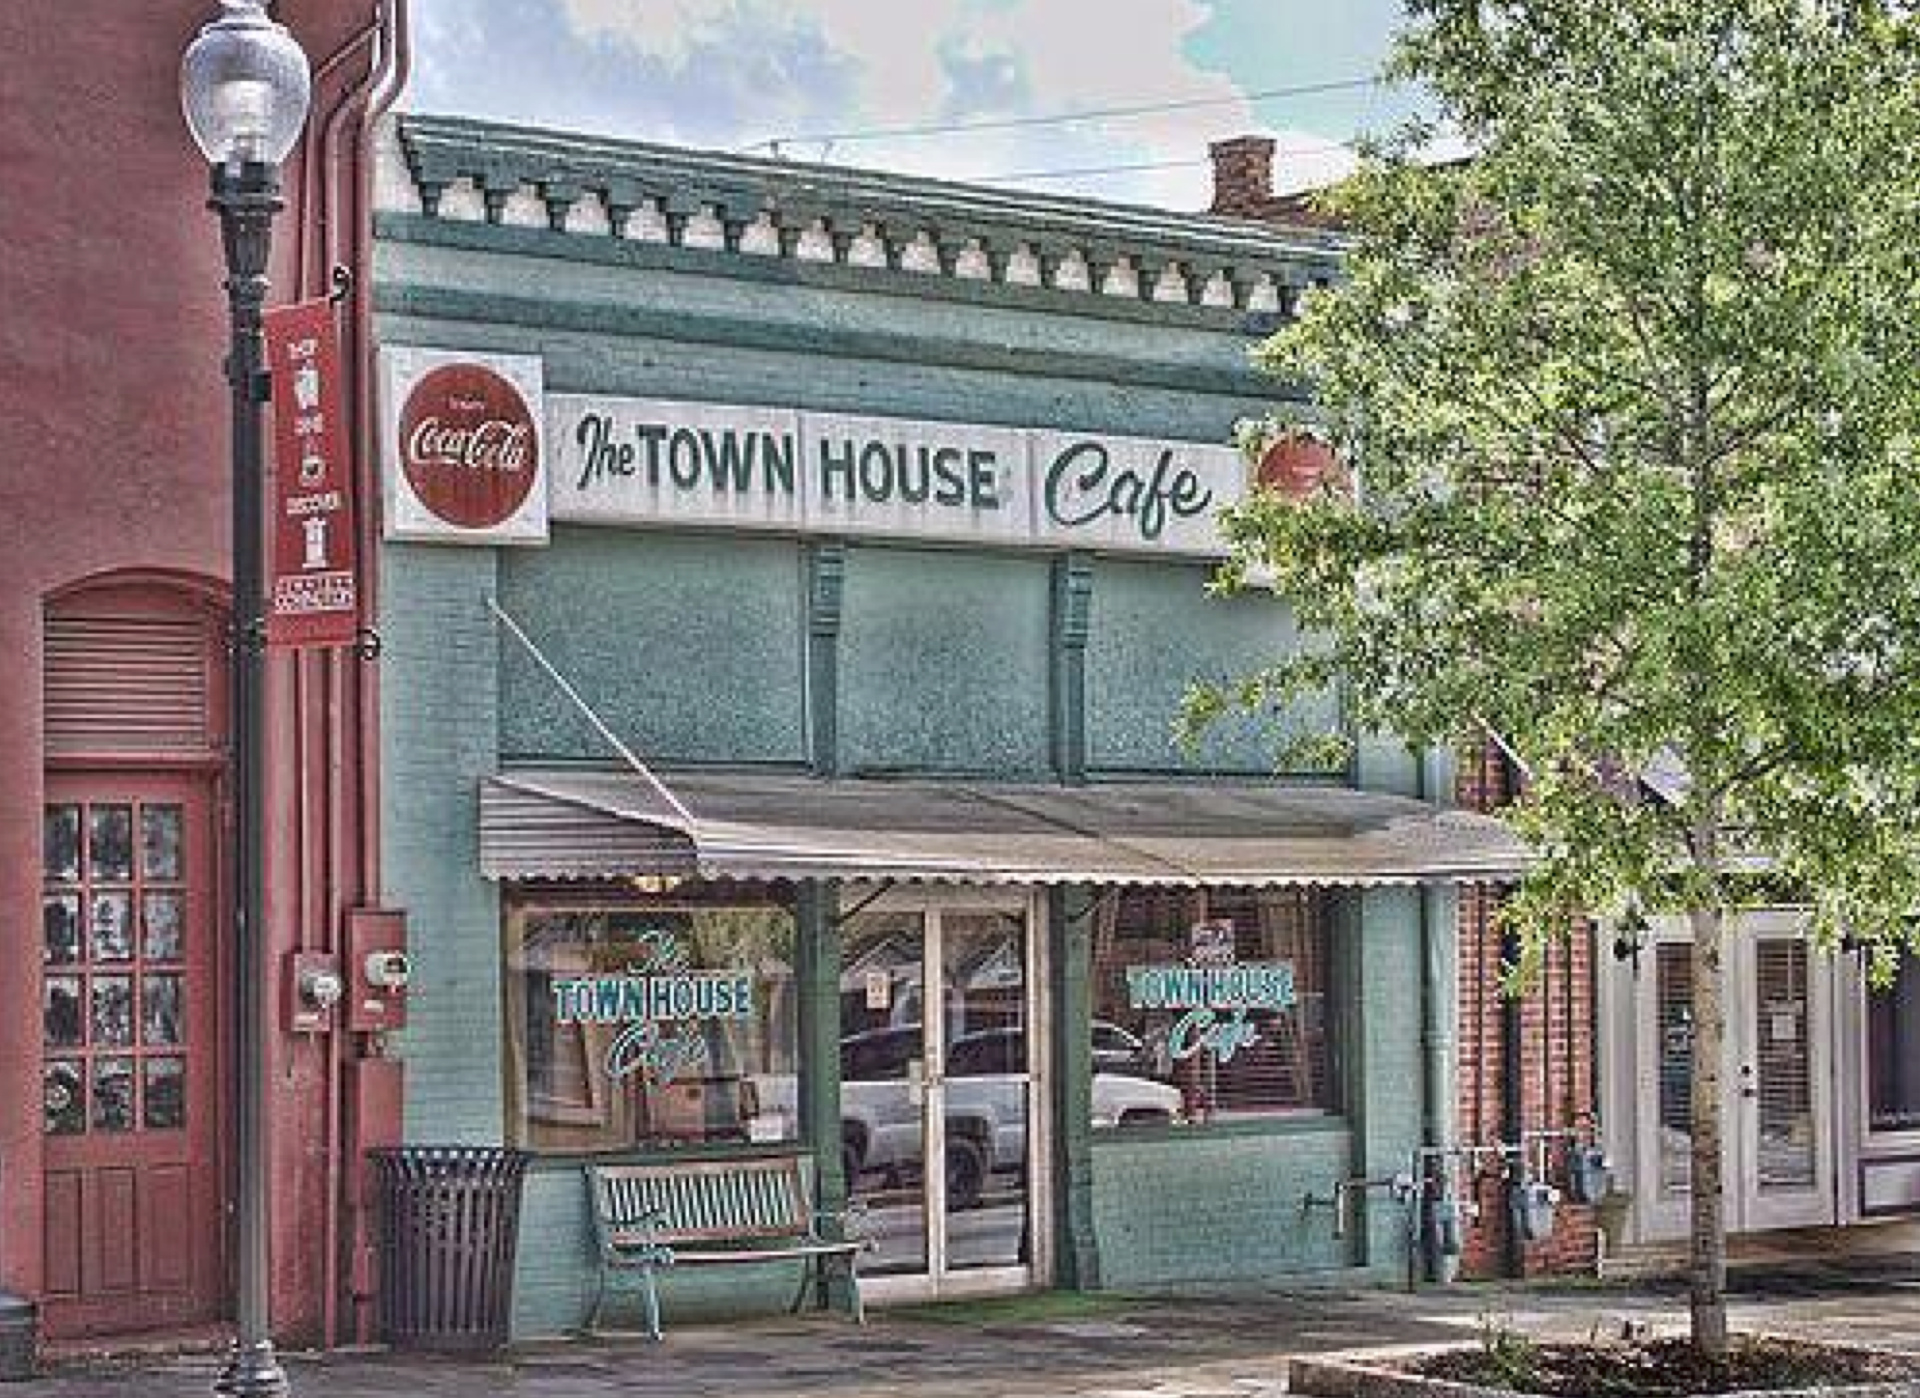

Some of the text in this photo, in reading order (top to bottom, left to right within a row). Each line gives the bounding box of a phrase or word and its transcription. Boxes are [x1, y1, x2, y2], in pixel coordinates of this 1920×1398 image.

[575, 411, 1213, 541] The TOWN HOUSE Cafe
[550, 975, 753, 1024] TOWN HOUSE
[1126, 961, 1297, 1009] TOWN HOUSE
[604, 1020, 710, 1086] Cafe
[1168, 1005, 1262, 1063] Cafe
